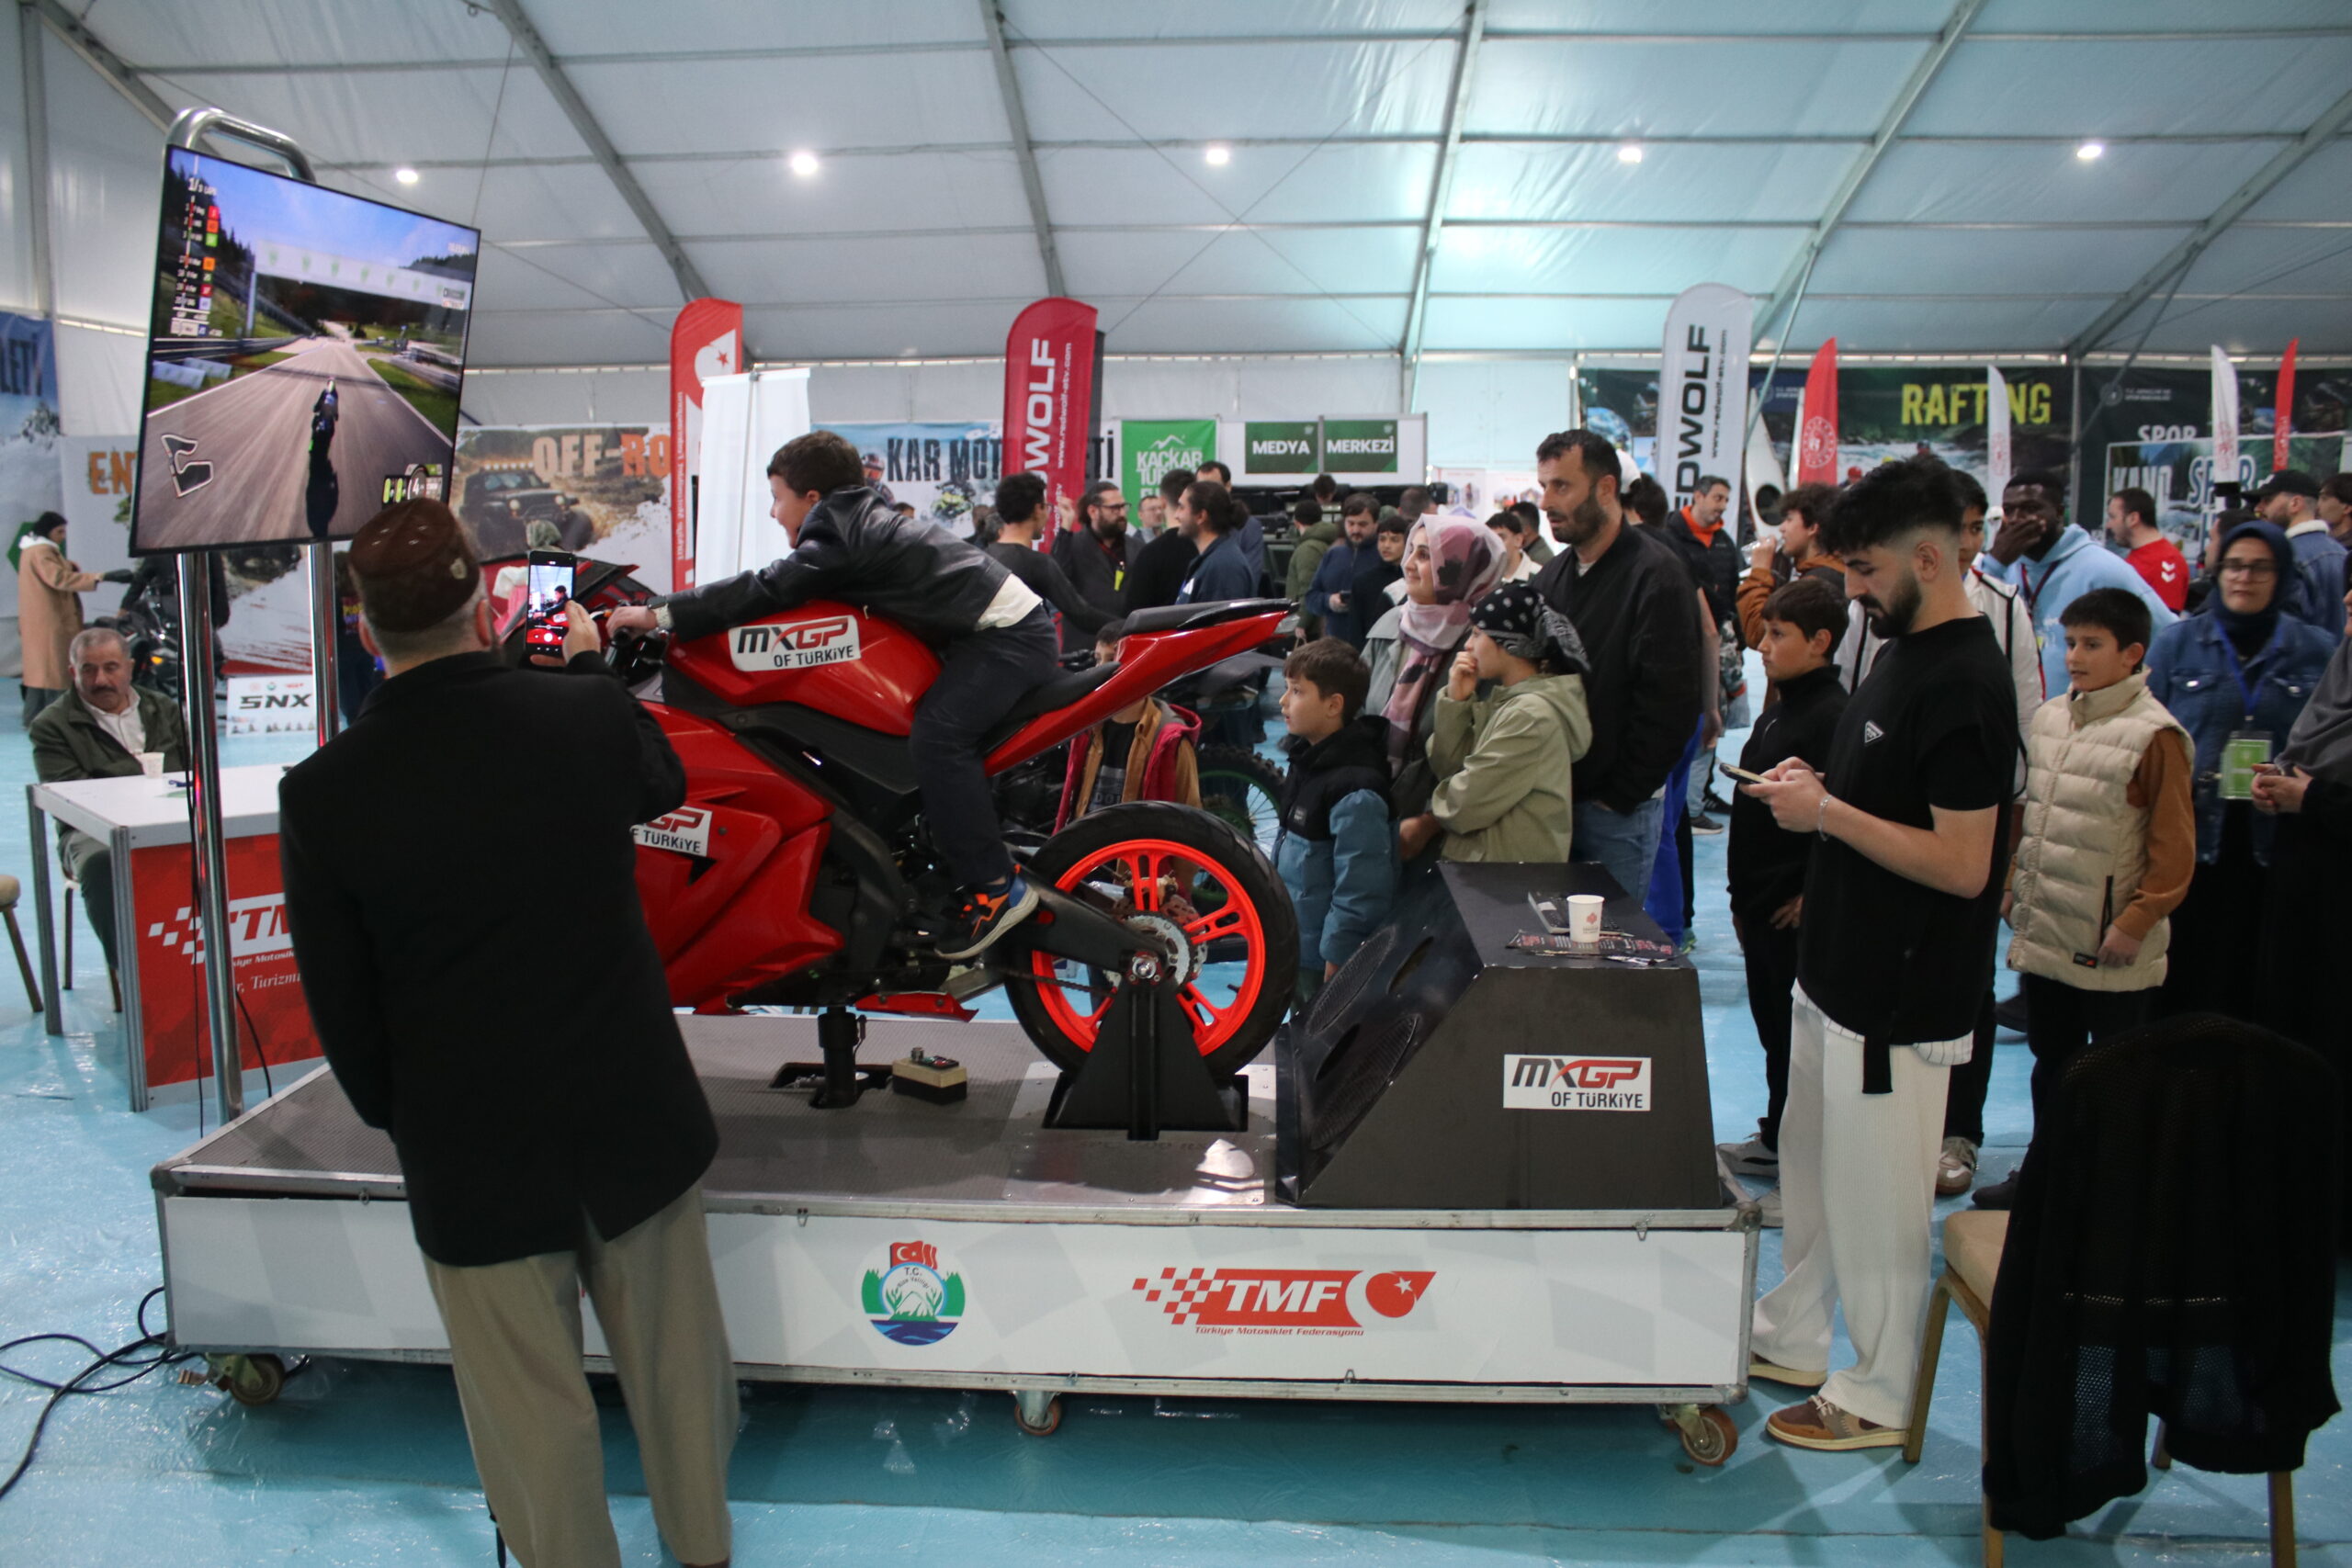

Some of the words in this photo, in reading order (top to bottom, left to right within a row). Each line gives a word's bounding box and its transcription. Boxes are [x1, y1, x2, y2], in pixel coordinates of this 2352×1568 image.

[1057, 342, 1071, 468] www.redwolf-atv.com
[1902, 383, 2052, 424] RAFTNG
[888, 438, 941, 481] KAR
[1252, 440, 1310, 455] MEDYA
[1327, 436, 1394, 454] MERKEZİ
[738, 617, 848, 654] MXGP
[774, 654, 791, 668] OF
[240, 694, 311, 709] SNX
[1512, 1058, 1642, 1090] MXGP
[1552, 1092, 1571, 1107] OF
[1226, 1279, 1340, 1312] TMF
[1195, 1325, 1234, 1337] Türkiye
[1237, 1326, 1294, 1336] Motosiklet
[1296, 1327, 1364, 1337] Federasyonu
